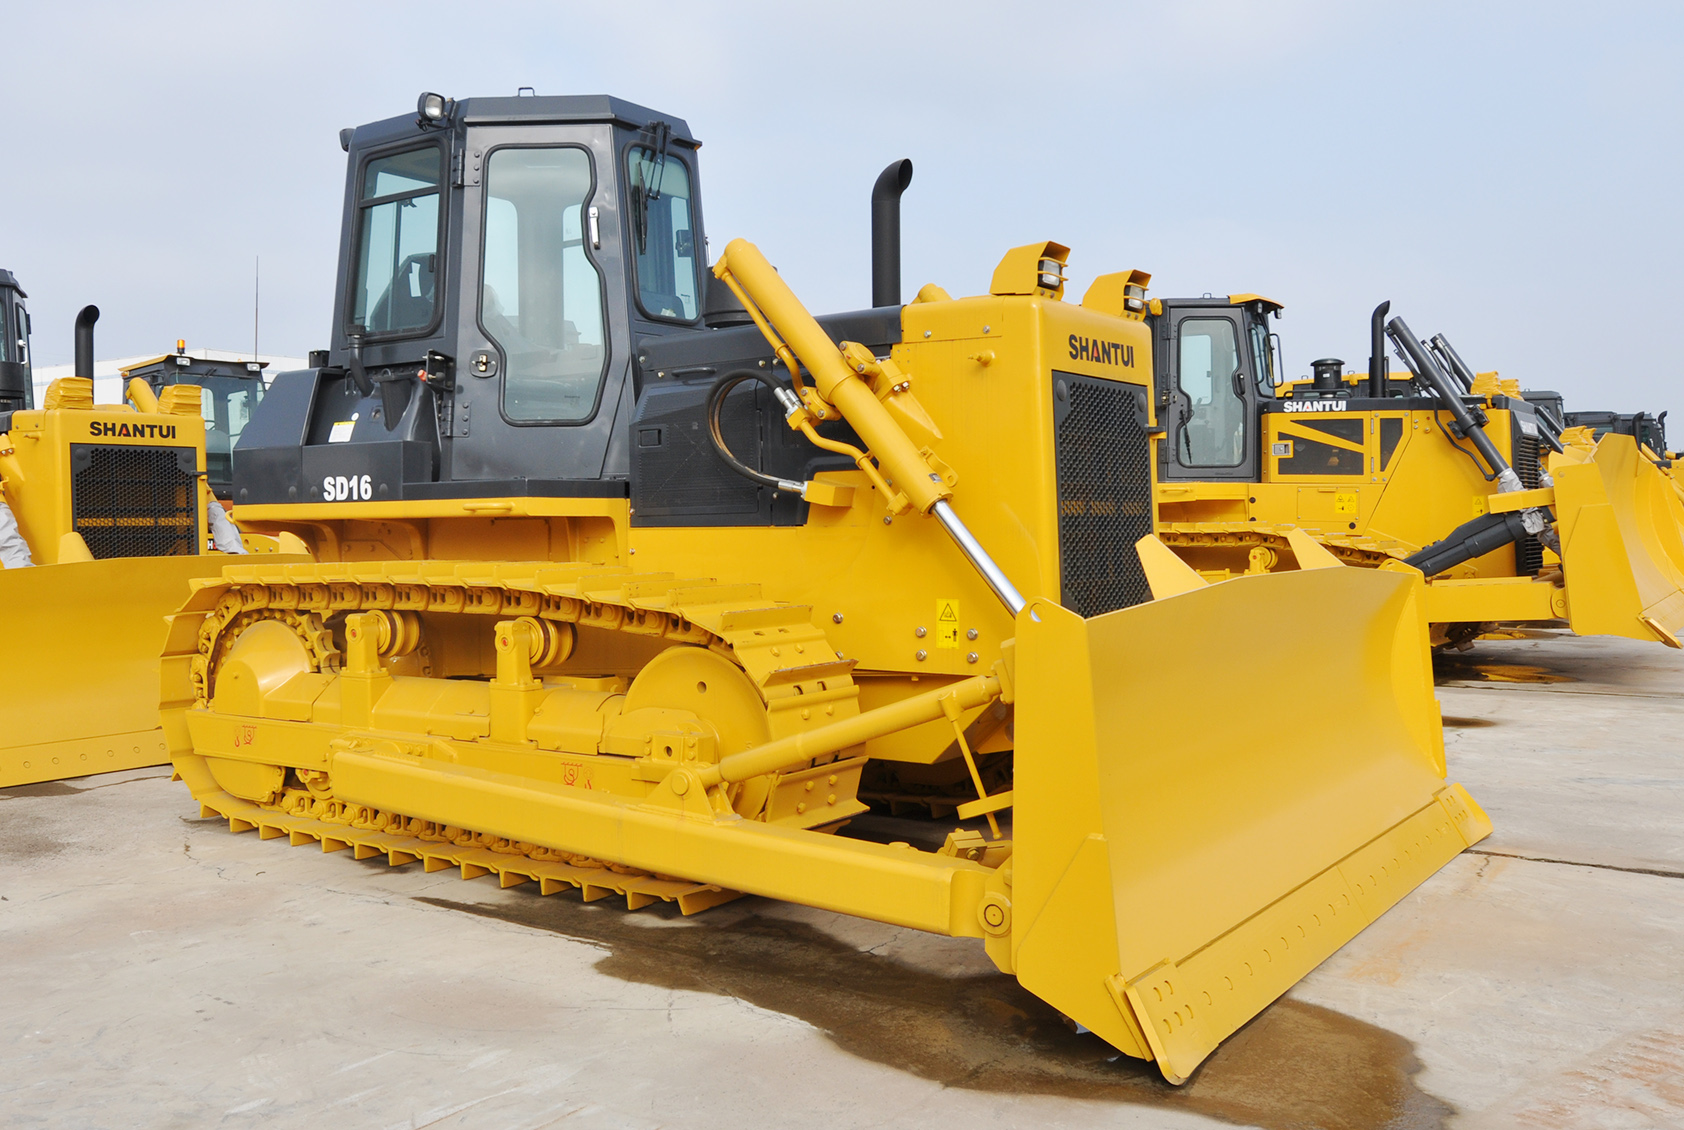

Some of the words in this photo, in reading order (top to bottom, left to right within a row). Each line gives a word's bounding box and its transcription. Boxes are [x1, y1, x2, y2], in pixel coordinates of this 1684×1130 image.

[1068, 333, 1135, 368] SHANTUI
[1283, 400, 1347, 413] SHANTUI
[89, 421, 176, 439] SHANTUI
[323, 474, 373, 502] SD16
